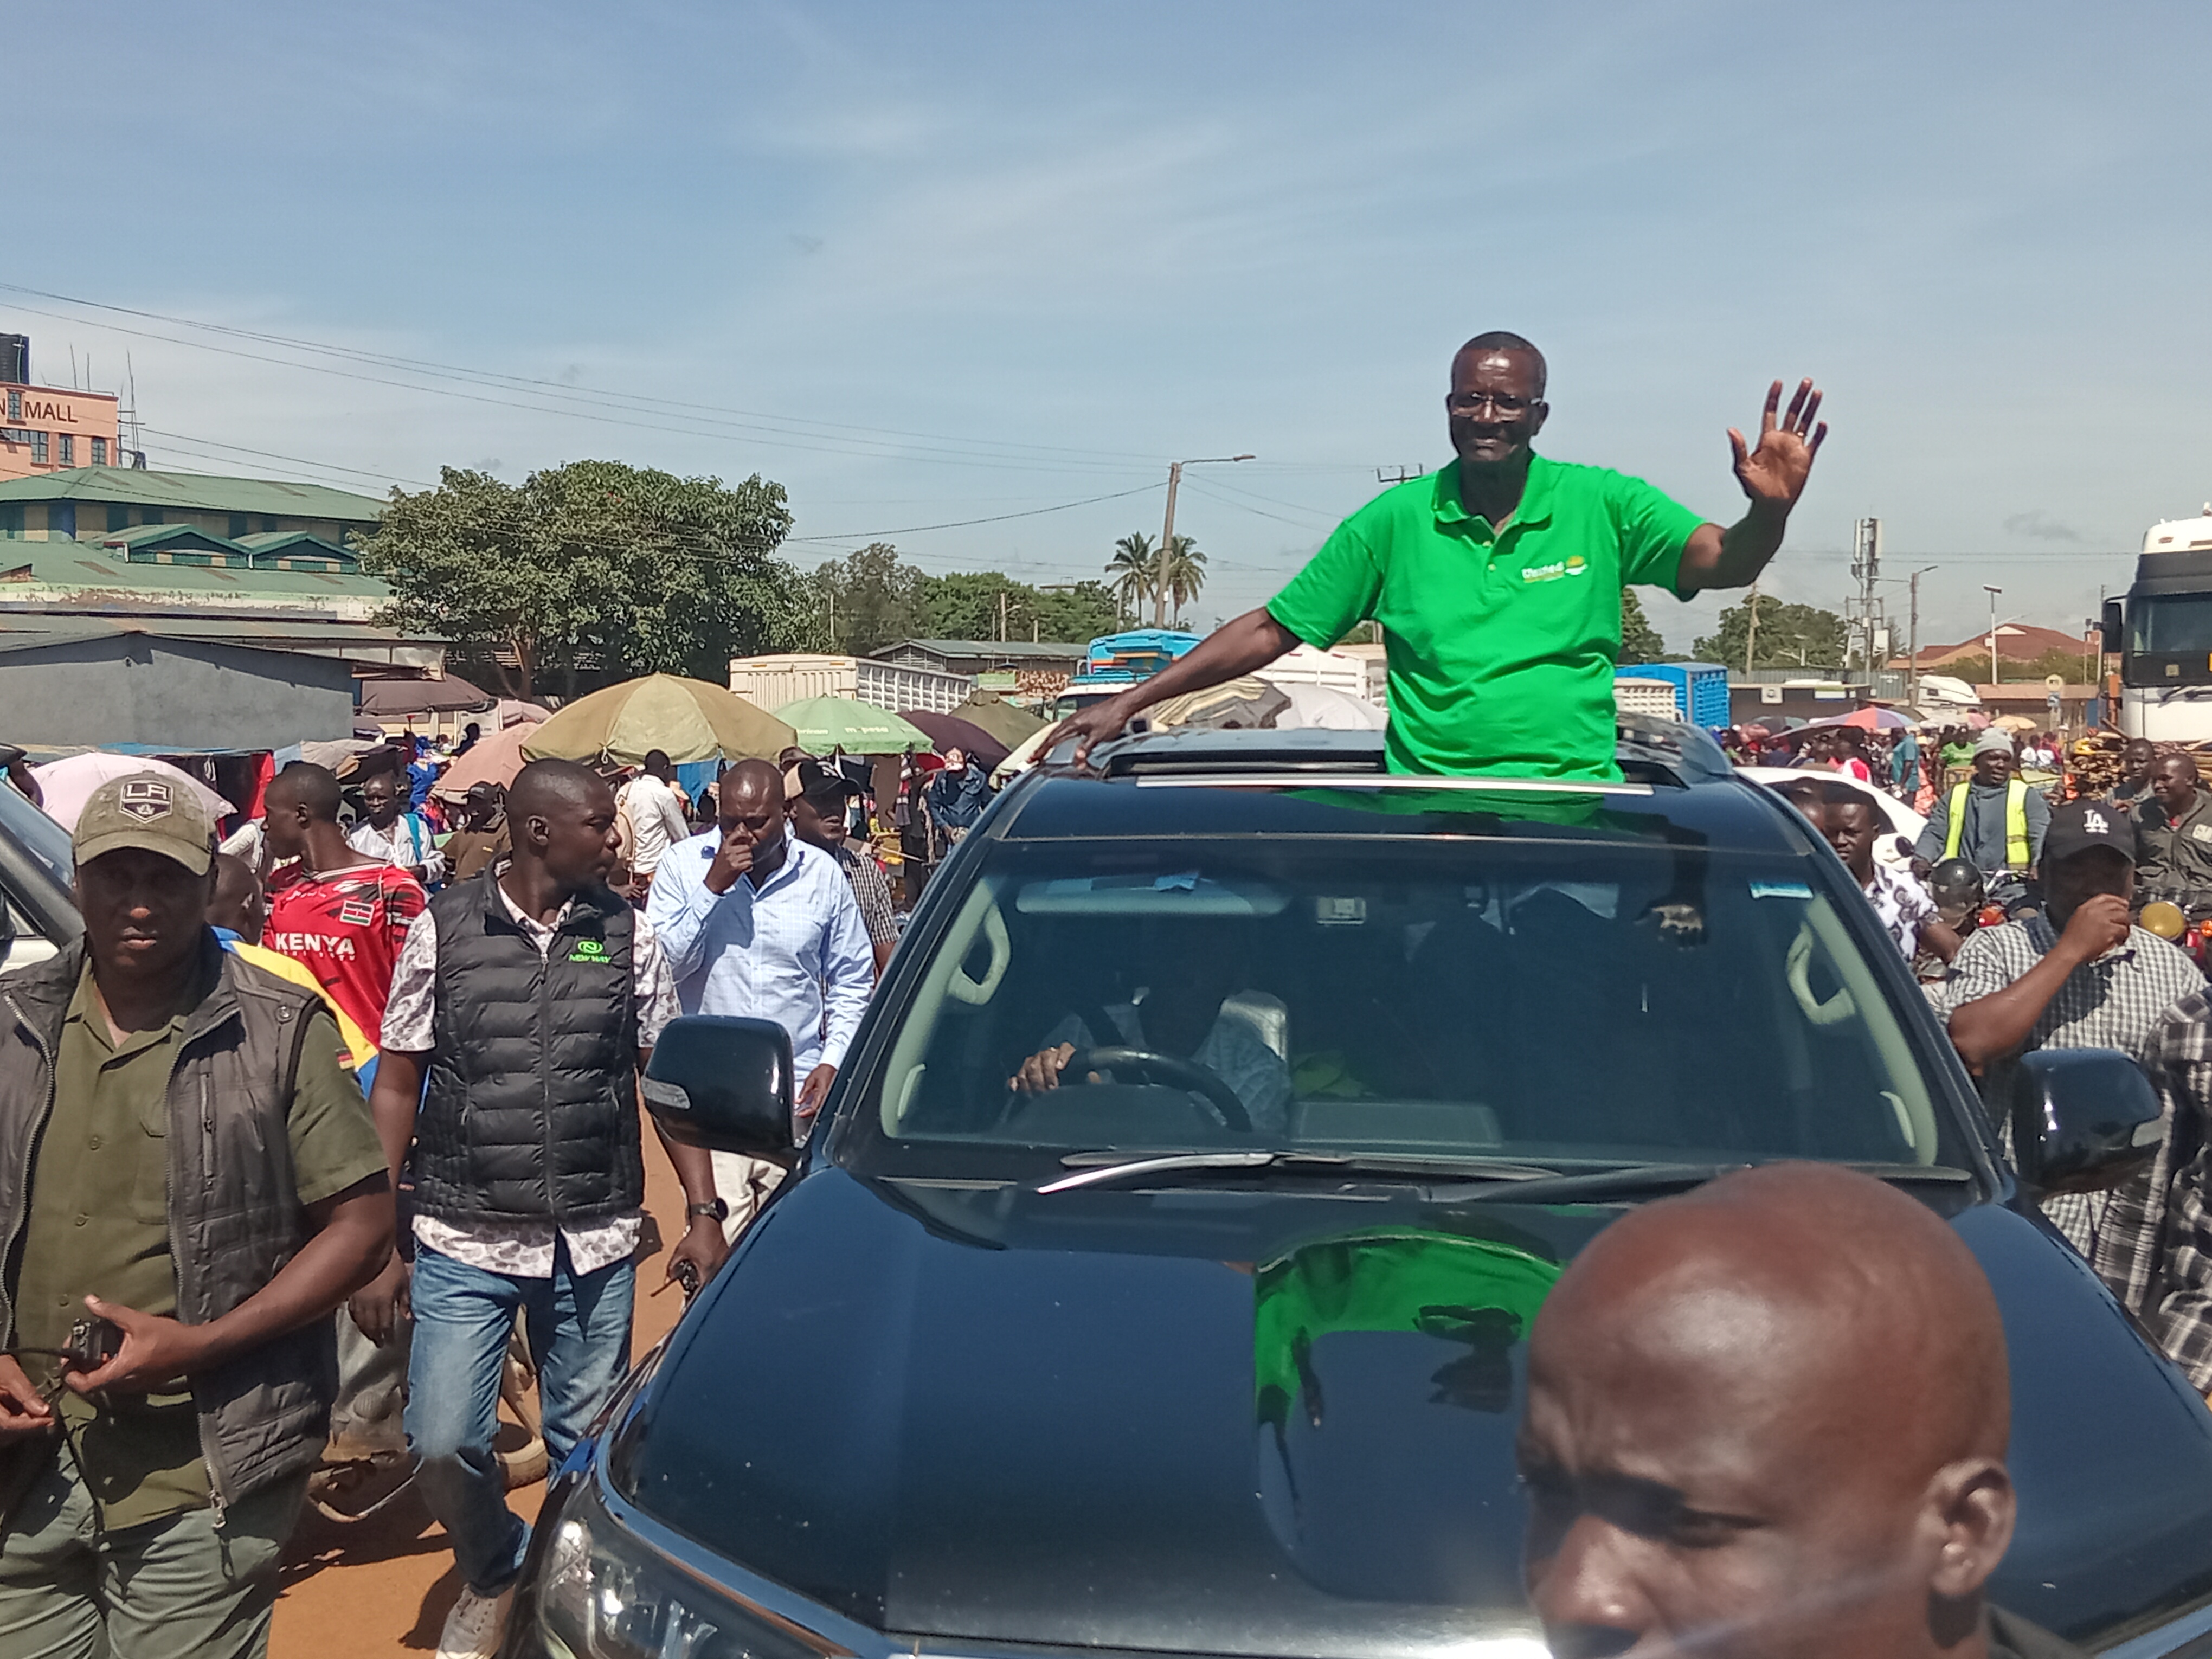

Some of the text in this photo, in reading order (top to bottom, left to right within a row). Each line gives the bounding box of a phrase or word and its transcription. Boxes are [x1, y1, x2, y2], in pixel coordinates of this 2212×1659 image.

[25, 401, 78, 423] MALL
[126, 784, 166, 800] LA
[2084, 809, 2108, 834] LA
[275, 933, 355, 955] KENYA
